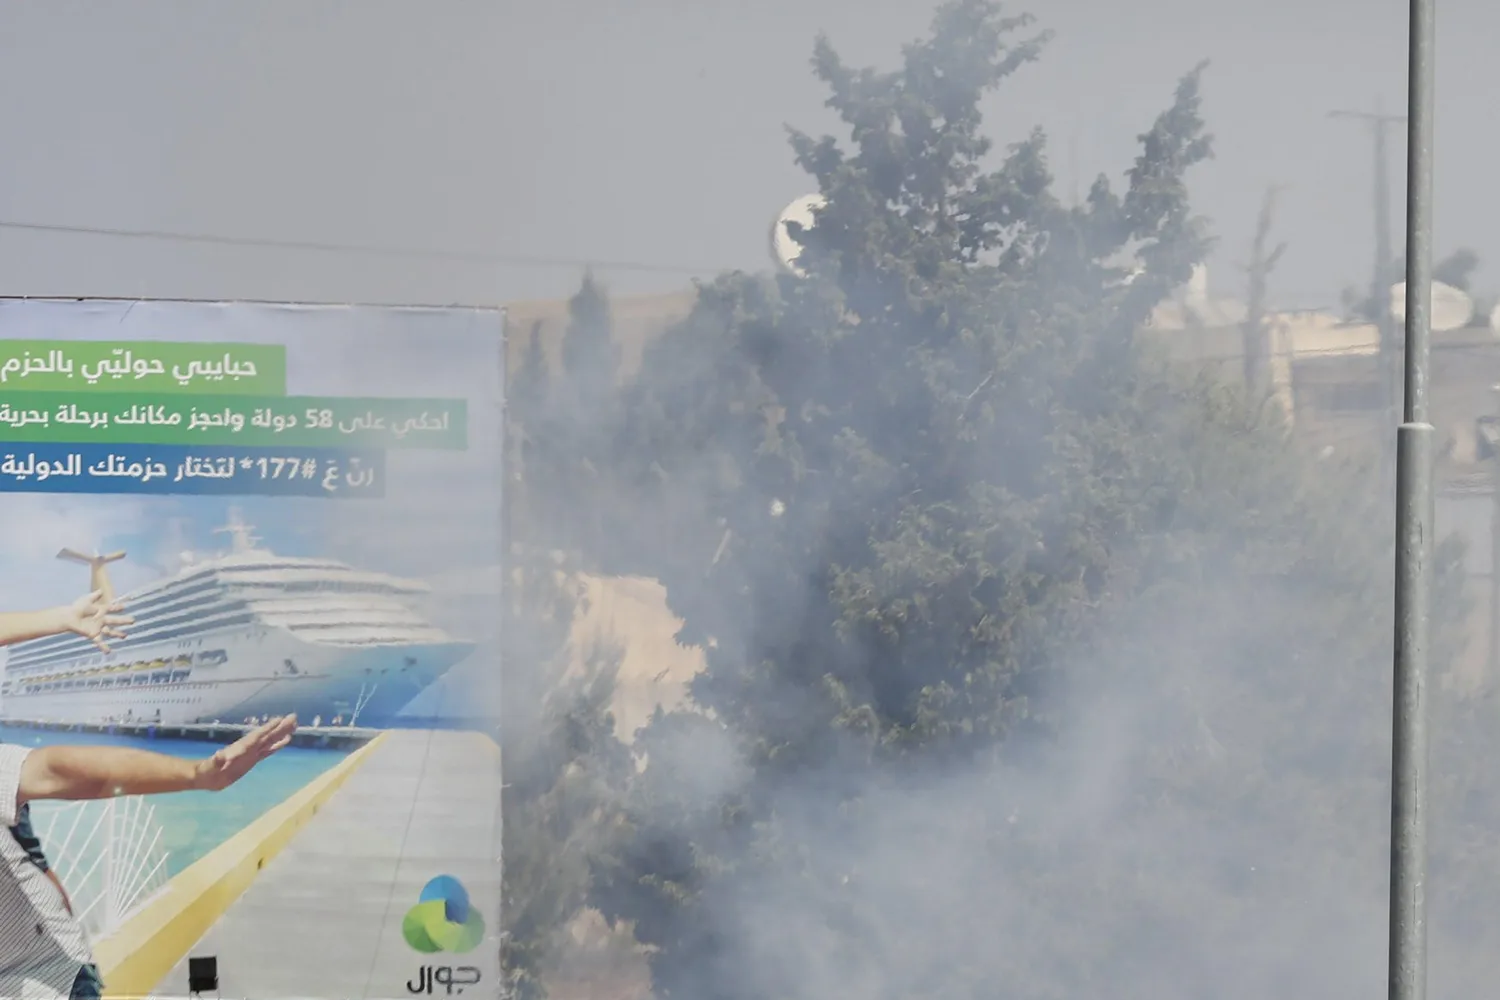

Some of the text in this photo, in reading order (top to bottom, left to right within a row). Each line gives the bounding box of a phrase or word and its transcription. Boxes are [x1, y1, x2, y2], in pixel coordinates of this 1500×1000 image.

[1, 350, 73, 382] بالحزم
[173, 353, 257, 385] حبايبي
[0, 404, 449, 439] احكي على 58 دولة واحجز مكانك برحلة بحرية
[1, 453, 81, 481] الدولية
[88, 454, 167, 482] حزمتك
[407, 965, 481, 995] جوال
